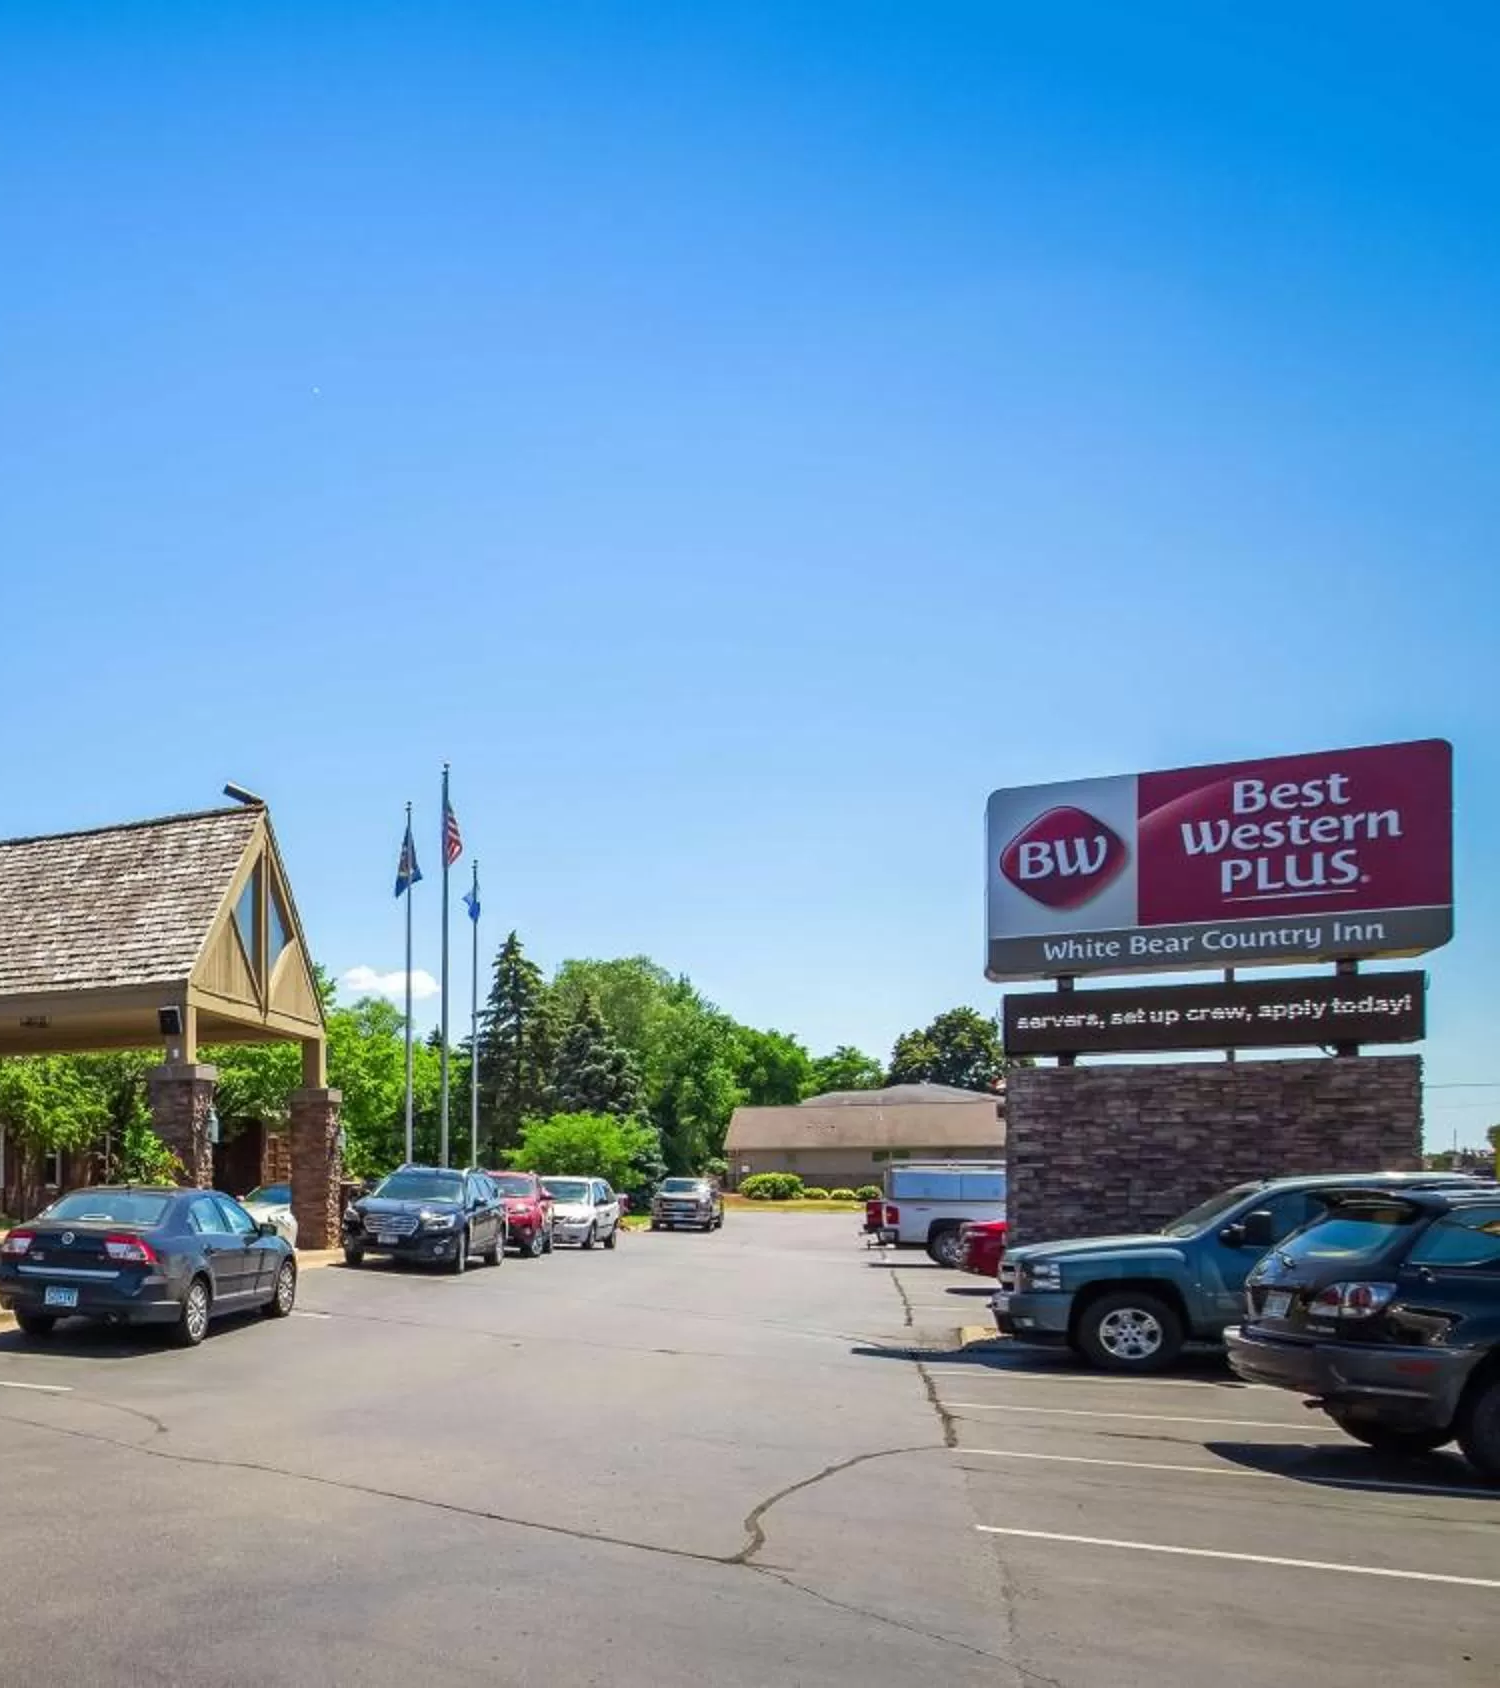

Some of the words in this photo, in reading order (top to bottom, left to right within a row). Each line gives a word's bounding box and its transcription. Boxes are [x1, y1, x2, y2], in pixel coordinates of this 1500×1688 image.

[1232, 773, 1351, 815] Best
[1180, 809, 1404, 855] Western
[1019, 835, 1108, 879] BW
[1043, 939, 1121, 961] White
[1129, 934, 1195, 956] Bear
[1202, 926, 1321, 950] Country
[1333, 921, 1385, 942] Inn
[1016, 1012, 1105, 1030] servers,
[1110, 1008, 1147, 1026] set
[1149, 1009, 1181, 1026] up
[1185, 1005, 1253, 1022] crew,
[1257, 999, 1327, 1020] apply
[1331, 993, 1412, 1015] today!
